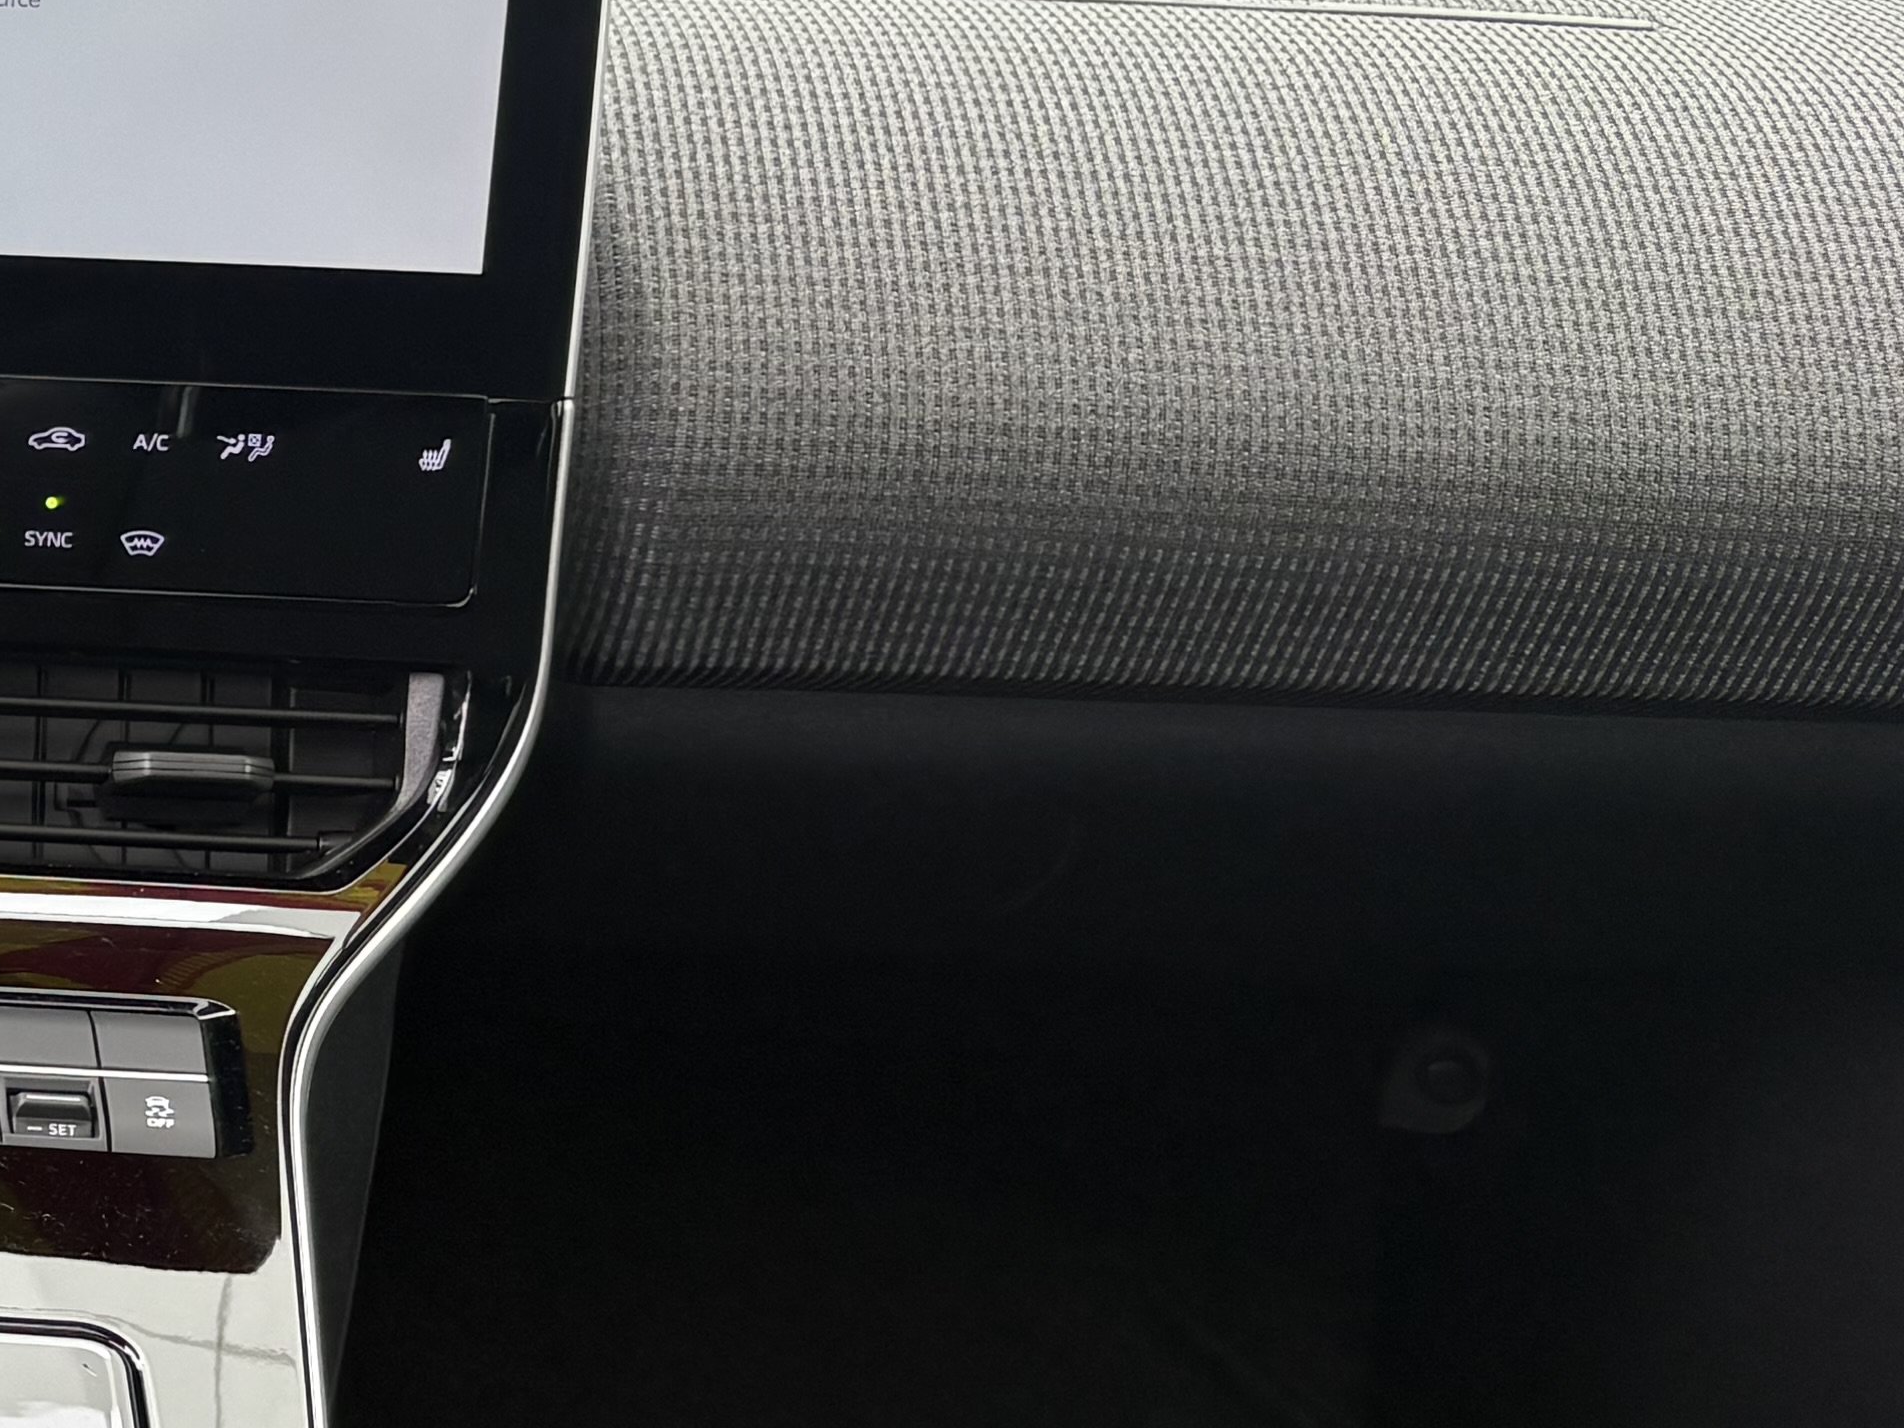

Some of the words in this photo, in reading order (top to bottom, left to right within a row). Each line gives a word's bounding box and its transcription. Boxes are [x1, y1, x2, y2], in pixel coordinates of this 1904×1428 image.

[132, 432, 170, 454] A/C
[23, 529, 74, 550] SYNC
[48, 1123, 77, 1137] SET
[145, 1116, 175, 1129] OFF
